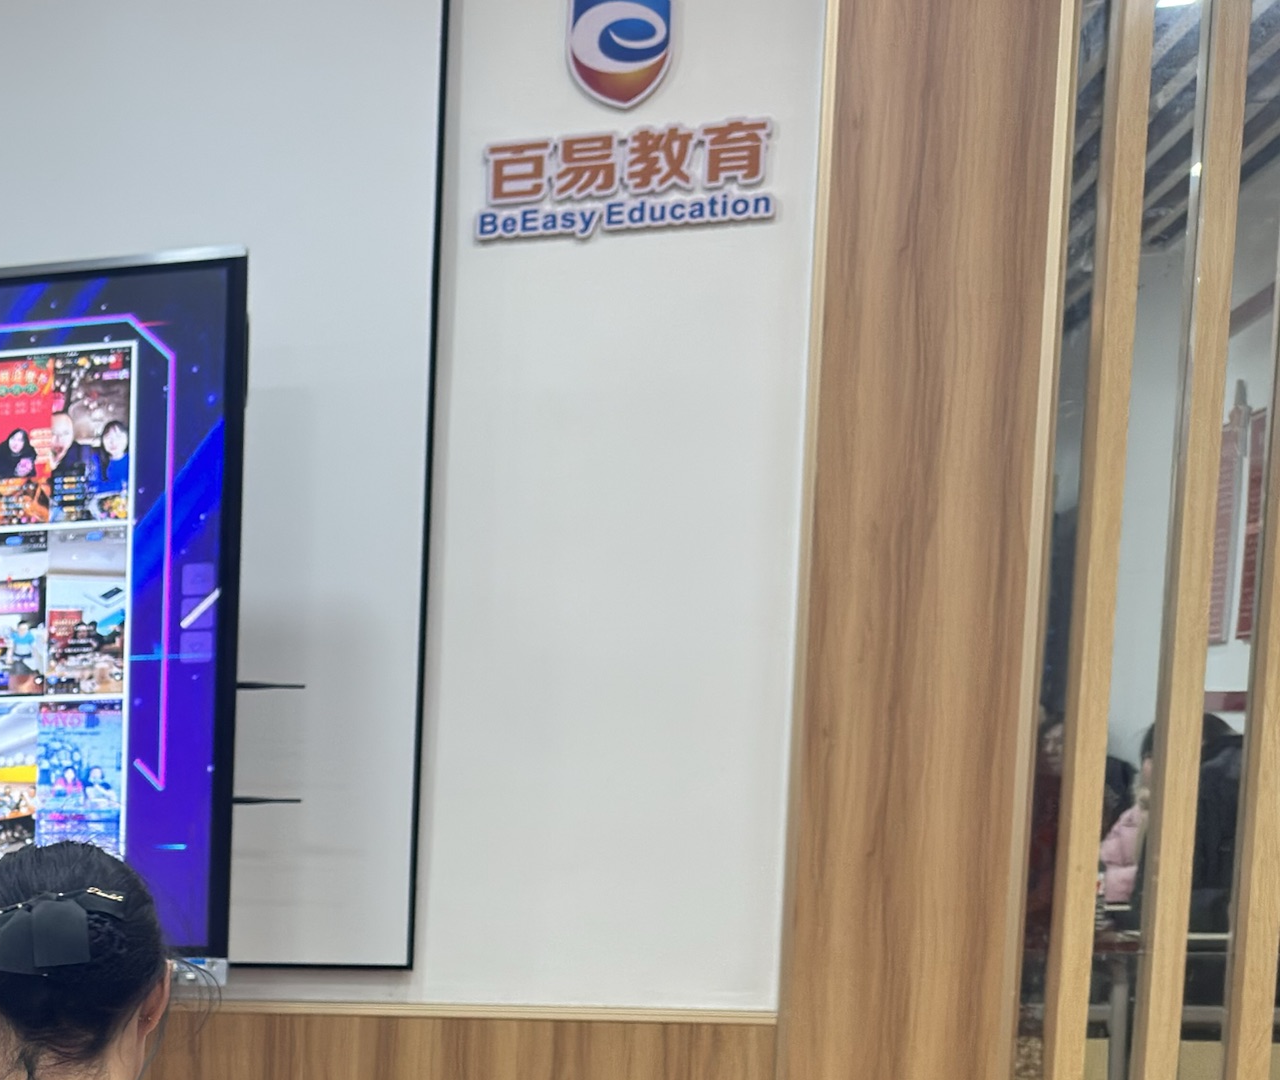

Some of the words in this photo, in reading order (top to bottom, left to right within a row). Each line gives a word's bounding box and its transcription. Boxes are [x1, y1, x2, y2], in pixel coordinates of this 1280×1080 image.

[488, 121, 767, 200] 百易教育
[479, 208, 595, 236] BeEasy
[606, 194, 771, 226] Education
